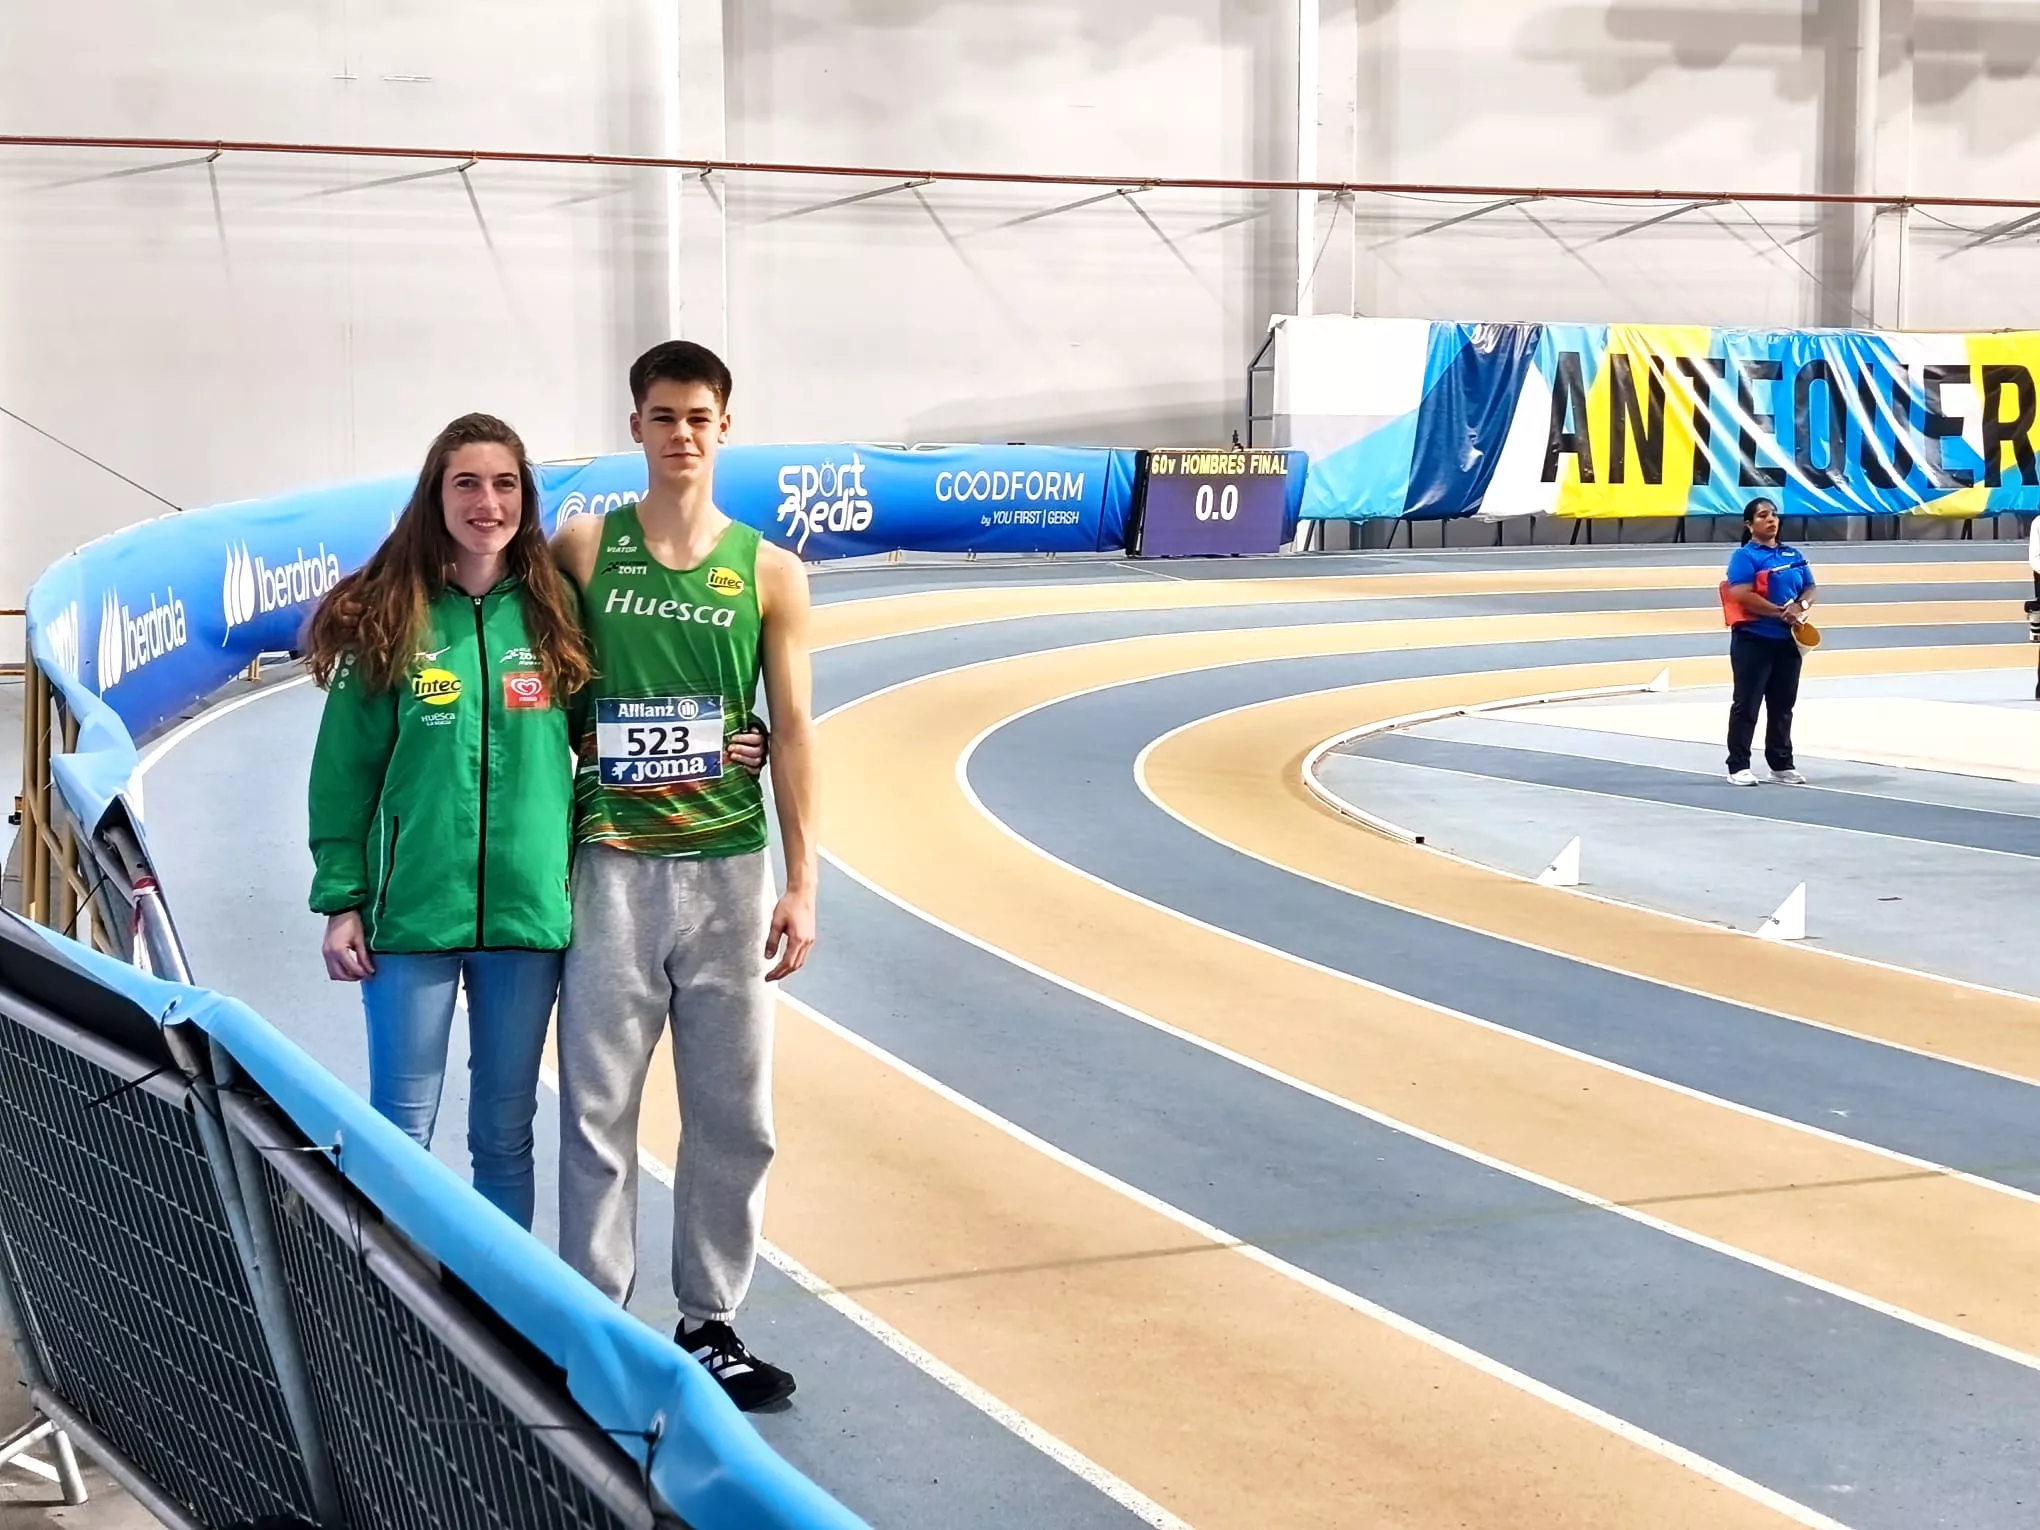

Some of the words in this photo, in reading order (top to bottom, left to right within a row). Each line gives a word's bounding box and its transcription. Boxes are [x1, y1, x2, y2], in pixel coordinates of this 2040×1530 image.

[1540, 350, 2040, 489] ANTEQUER
[1181, 454, 1245, 475] HOMBRES
[1250, 454, 1288, 475] FINAL
[935, 470, 1085, 501] GOODFORM
[1195, 484, 1239, 521] 0.0
[981, 514, 991, 527] by
[993, 510, 1012, 525] YOU
[1014, 510, 1041, 525] FIRST
[1048, 510, 1080, 525] GERSH
[606, 545, 638, 554] VIATOR
[254, 542, 340, 614] Iberdrola
[618, 565, 648, 576] ZOITI
[604, 588, 737, 628] Huesca
[121, 585, 188, 673] Iberdrola
[617, 703, 675, 718] Allianz
[627, 726, 690, 757] 523
